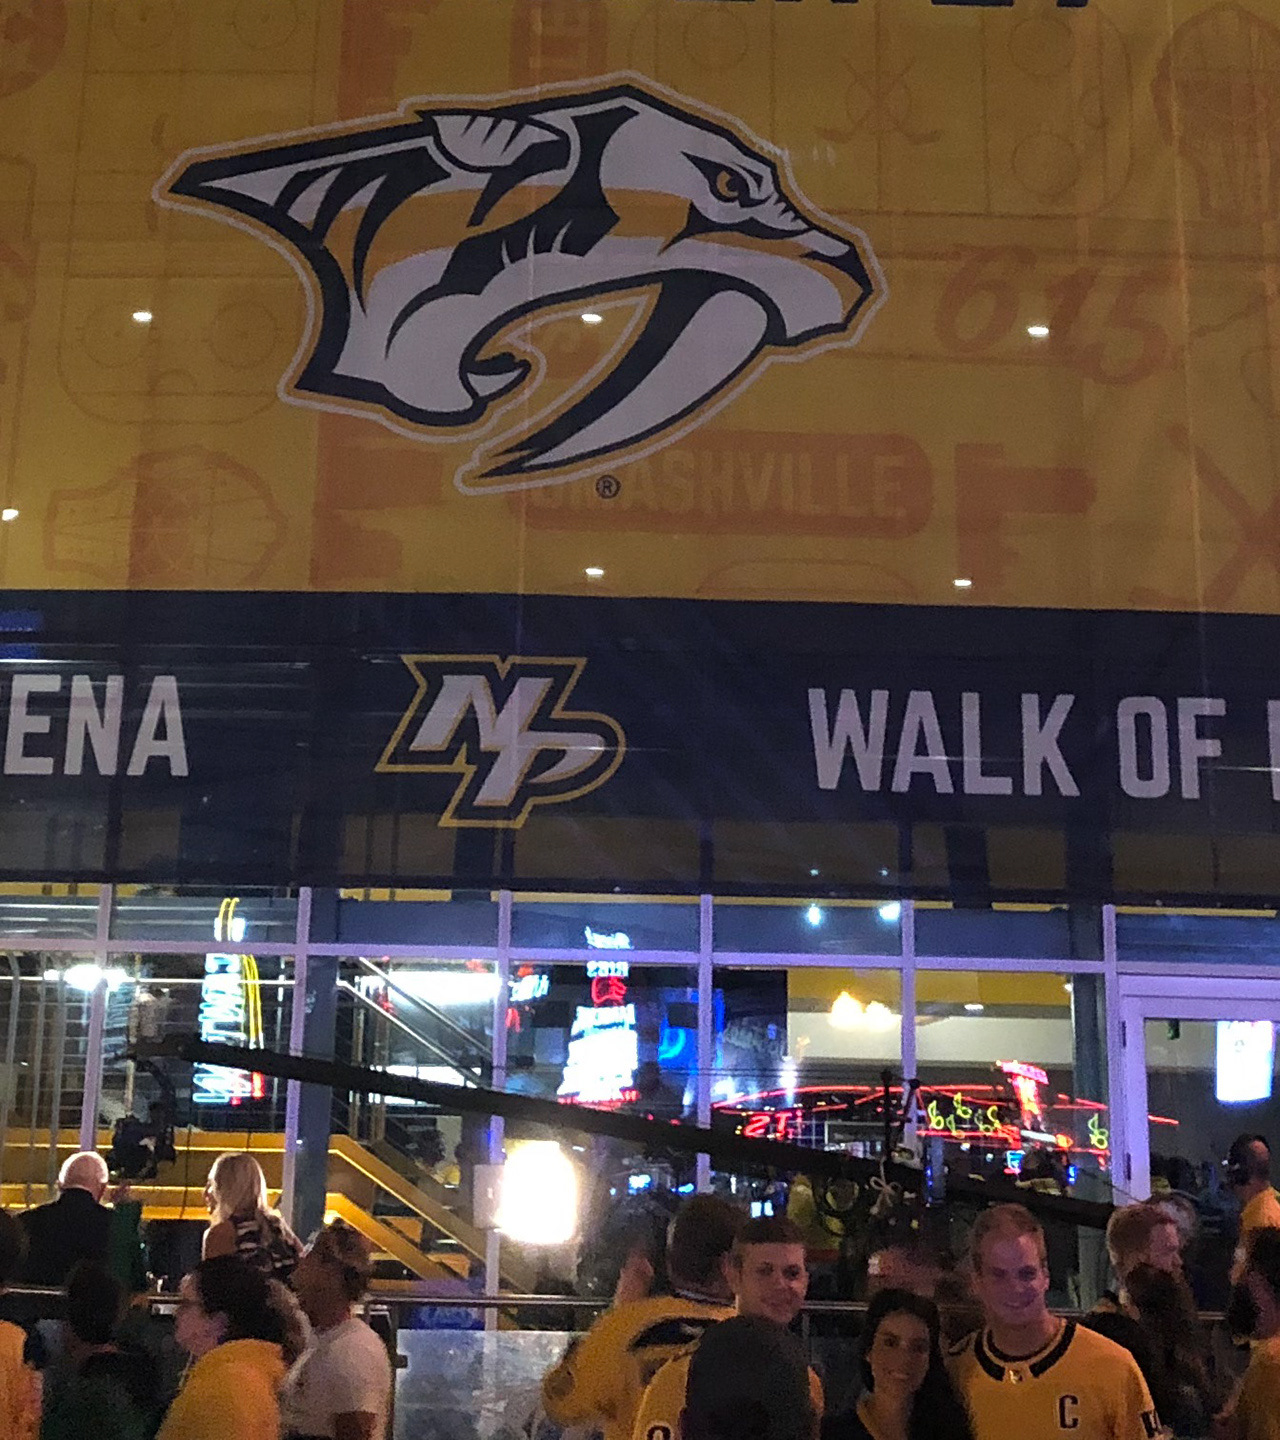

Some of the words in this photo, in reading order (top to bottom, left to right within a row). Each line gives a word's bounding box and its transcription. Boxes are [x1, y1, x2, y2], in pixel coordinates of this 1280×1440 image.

[807, 687, 1081, 798] WALK
[1119, 696, 1227, 801] OF
[1058, 1394, 1080, 1430] C
